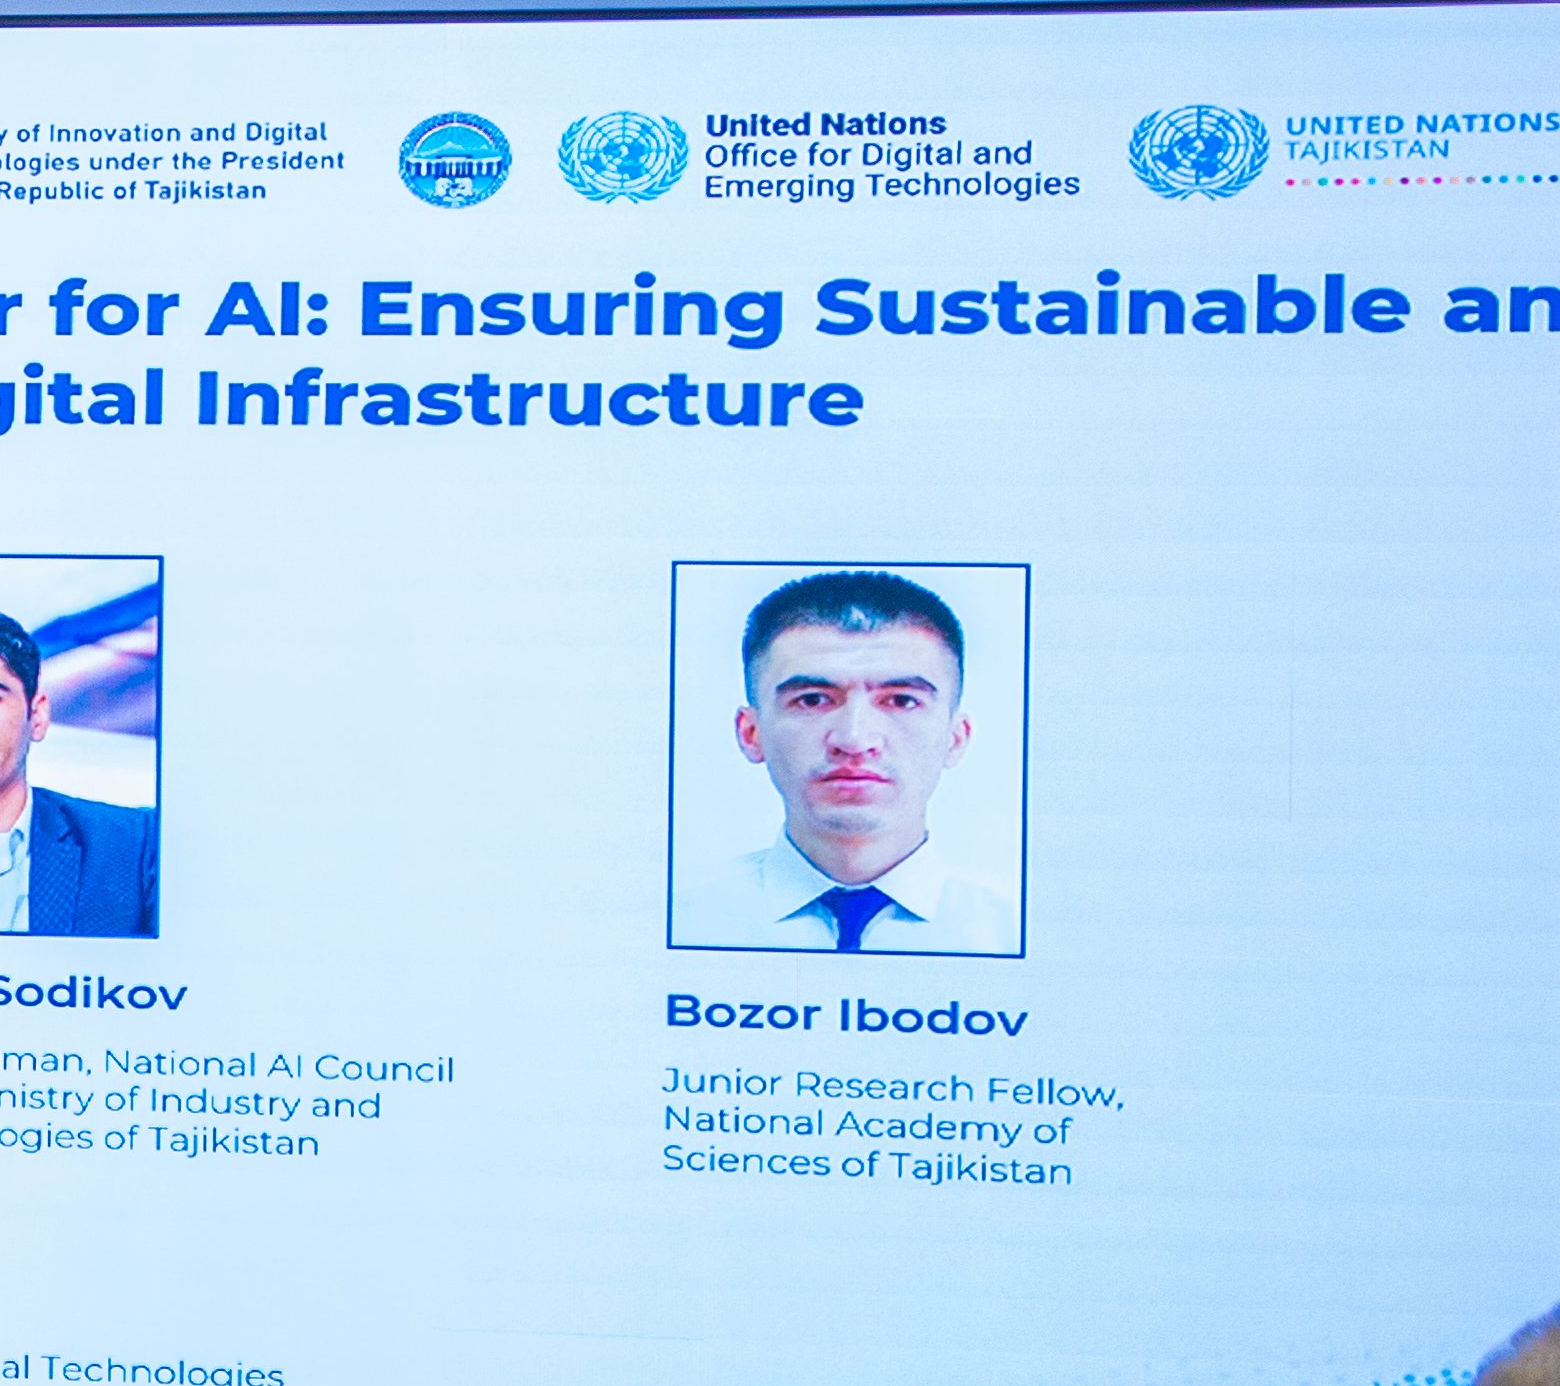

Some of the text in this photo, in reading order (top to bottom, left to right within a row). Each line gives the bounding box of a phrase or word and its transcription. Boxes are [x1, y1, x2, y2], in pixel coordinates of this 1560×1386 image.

[17, 124, 40, 143] of
[50, 123, 181, 142] Innovation
[190, 123, 235, 142] and
[246, 122, 327, 146] Digital
[707, 111, 947, 137] United Nations
[1287, 112, 1560, 136] UNITED NATIONS
[89, 152, 163, 171] under
[172, 152, 211, 170] the
[222, 151, 344, 170] President
[705, 140, 1032, 172] Office for Digital and
[1285, 139, 1449, 165] TAJIKISTAN
[113, 181, 136, 200] of
[144, 180, 266, 204] Tajikistan
[705, 171, 1080, 203] Emerging Technologies
[49, 277, 180, 336] for
[205, 281, 328, 336] AI:
[361, 271, 783, 350] Ensuring
[816, 269, 1411, 336] Sustainable
[1444, 286, 1560, 333] an
[198, 367, 864, 427] Infrastructure
[667, 994, 1028, 1037] Bozor Ibodov
[105, 1049, 255, 1077] National
[267, 1054, 301, 1078] AI
[315, 1054, 453, 1083] Council
[105, 1085, 140, 1111] of
[152, 1088, 301, 1122] Industry
[312, 1092, 380, 1118] and
[662, 1067, 1124, 1111] Junior Research Fellow,
[104, 1124, 140, 1150] of
[148, 1126, 318, 1158] Tajikistan
[665, 1105, 1073, 1148] National Academy of
[664, 1144, 1071, 1185] Sciences of Tajikistan
